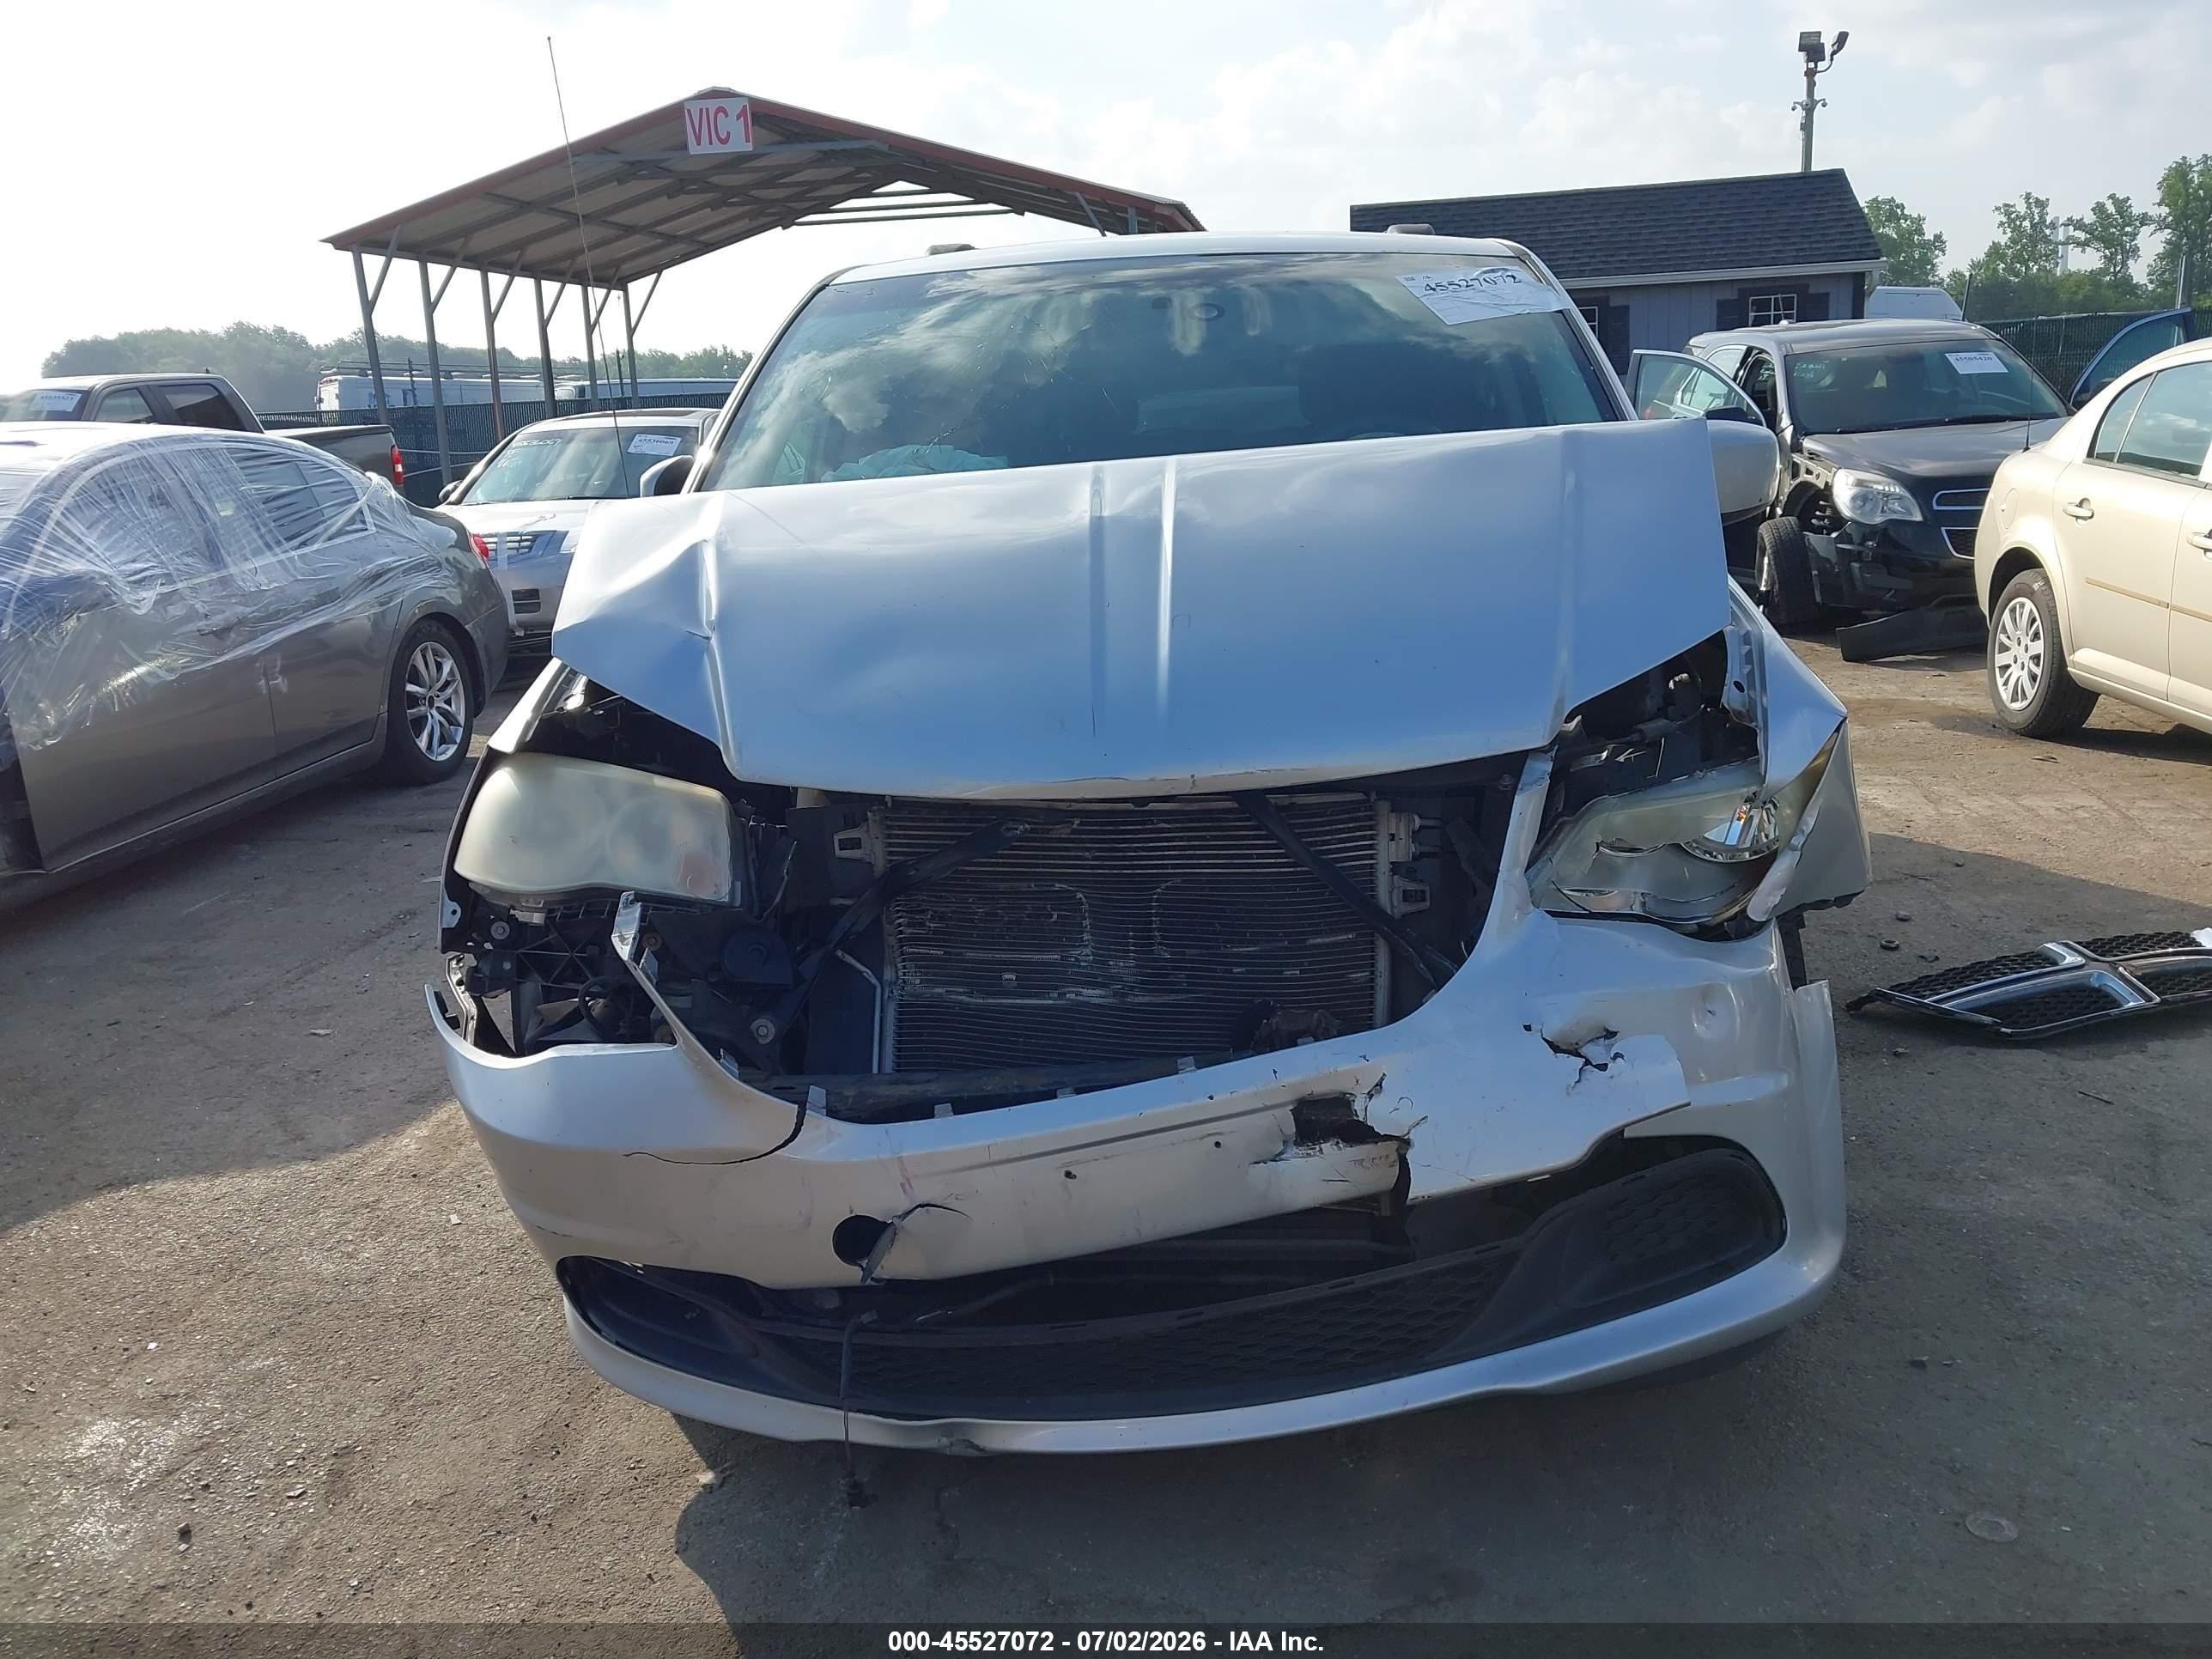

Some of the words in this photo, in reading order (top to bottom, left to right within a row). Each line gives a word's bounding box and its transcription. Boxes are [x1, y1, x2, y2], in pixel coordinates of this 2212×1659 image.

[686, 105, 731, 146] VIC
[736, 104, 751, 143] 1
[1425, 274, 1522, 291] 45527072
